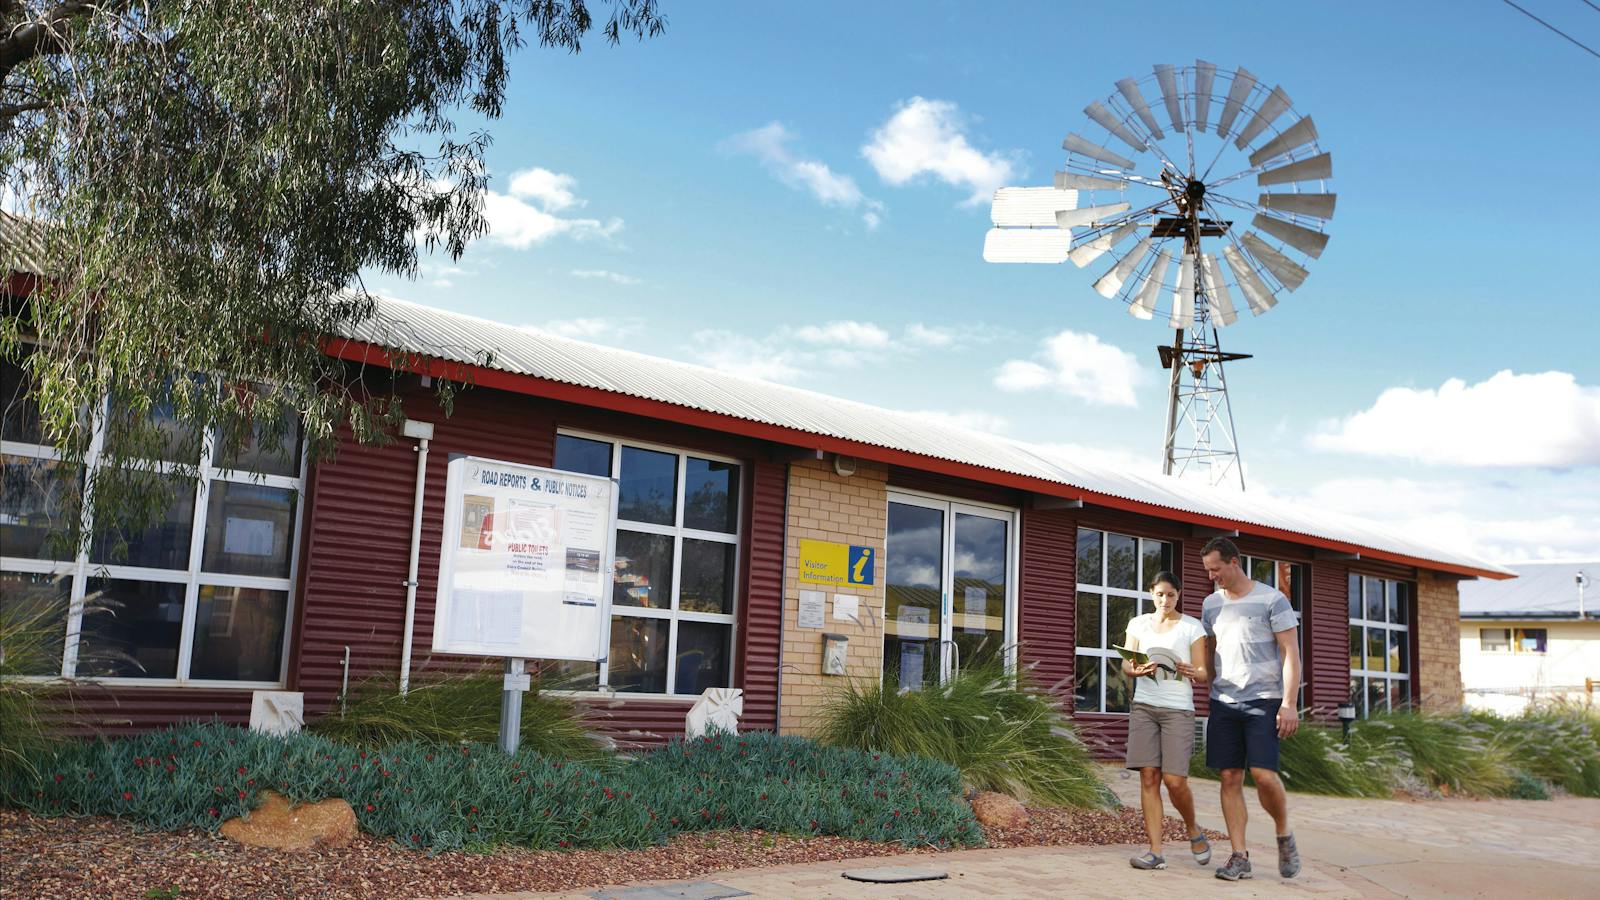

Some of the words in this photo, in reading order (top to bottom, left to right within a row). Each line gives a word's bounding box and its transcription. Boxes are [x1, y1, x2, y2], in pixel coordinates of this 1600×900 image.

[481, 470, 498, 486] ROAD
[500, 471, 526, 489] REPORTS
[530, 477, 541, 491] &
[545, 479, 564, 494] PUBLIC
[565, 482, 587, 498] NOTICES
[507, 543, 527, 553] PUBLIC
[804, 559, 828, 569] Visitor
[803, 571, 844, 583] Information
